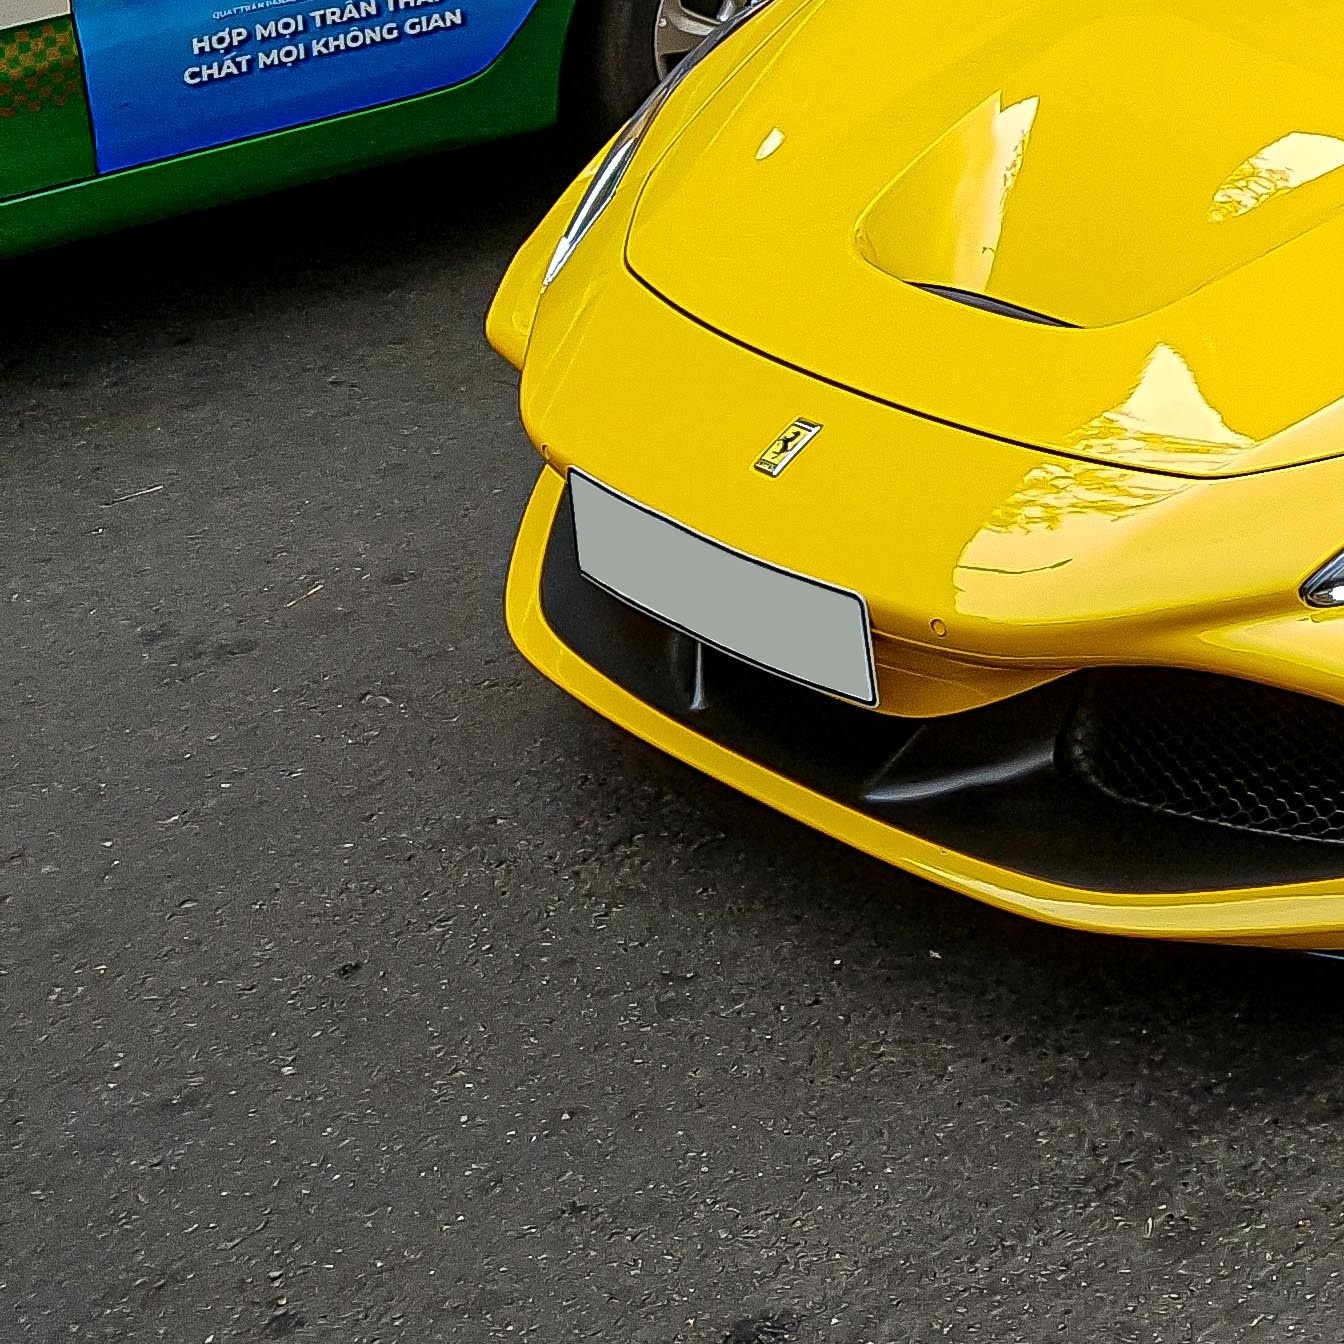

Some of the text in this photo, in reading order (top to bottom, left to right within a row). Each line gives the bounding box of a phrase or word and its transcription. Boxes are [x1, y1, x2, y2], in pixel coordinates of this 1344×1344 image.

[183, 8, 462, 85] CHẤT MỌI KHÔNG GIAN
[192, 26, 248, 56] HỢP
[255, 15, 304, 42] MỌI
